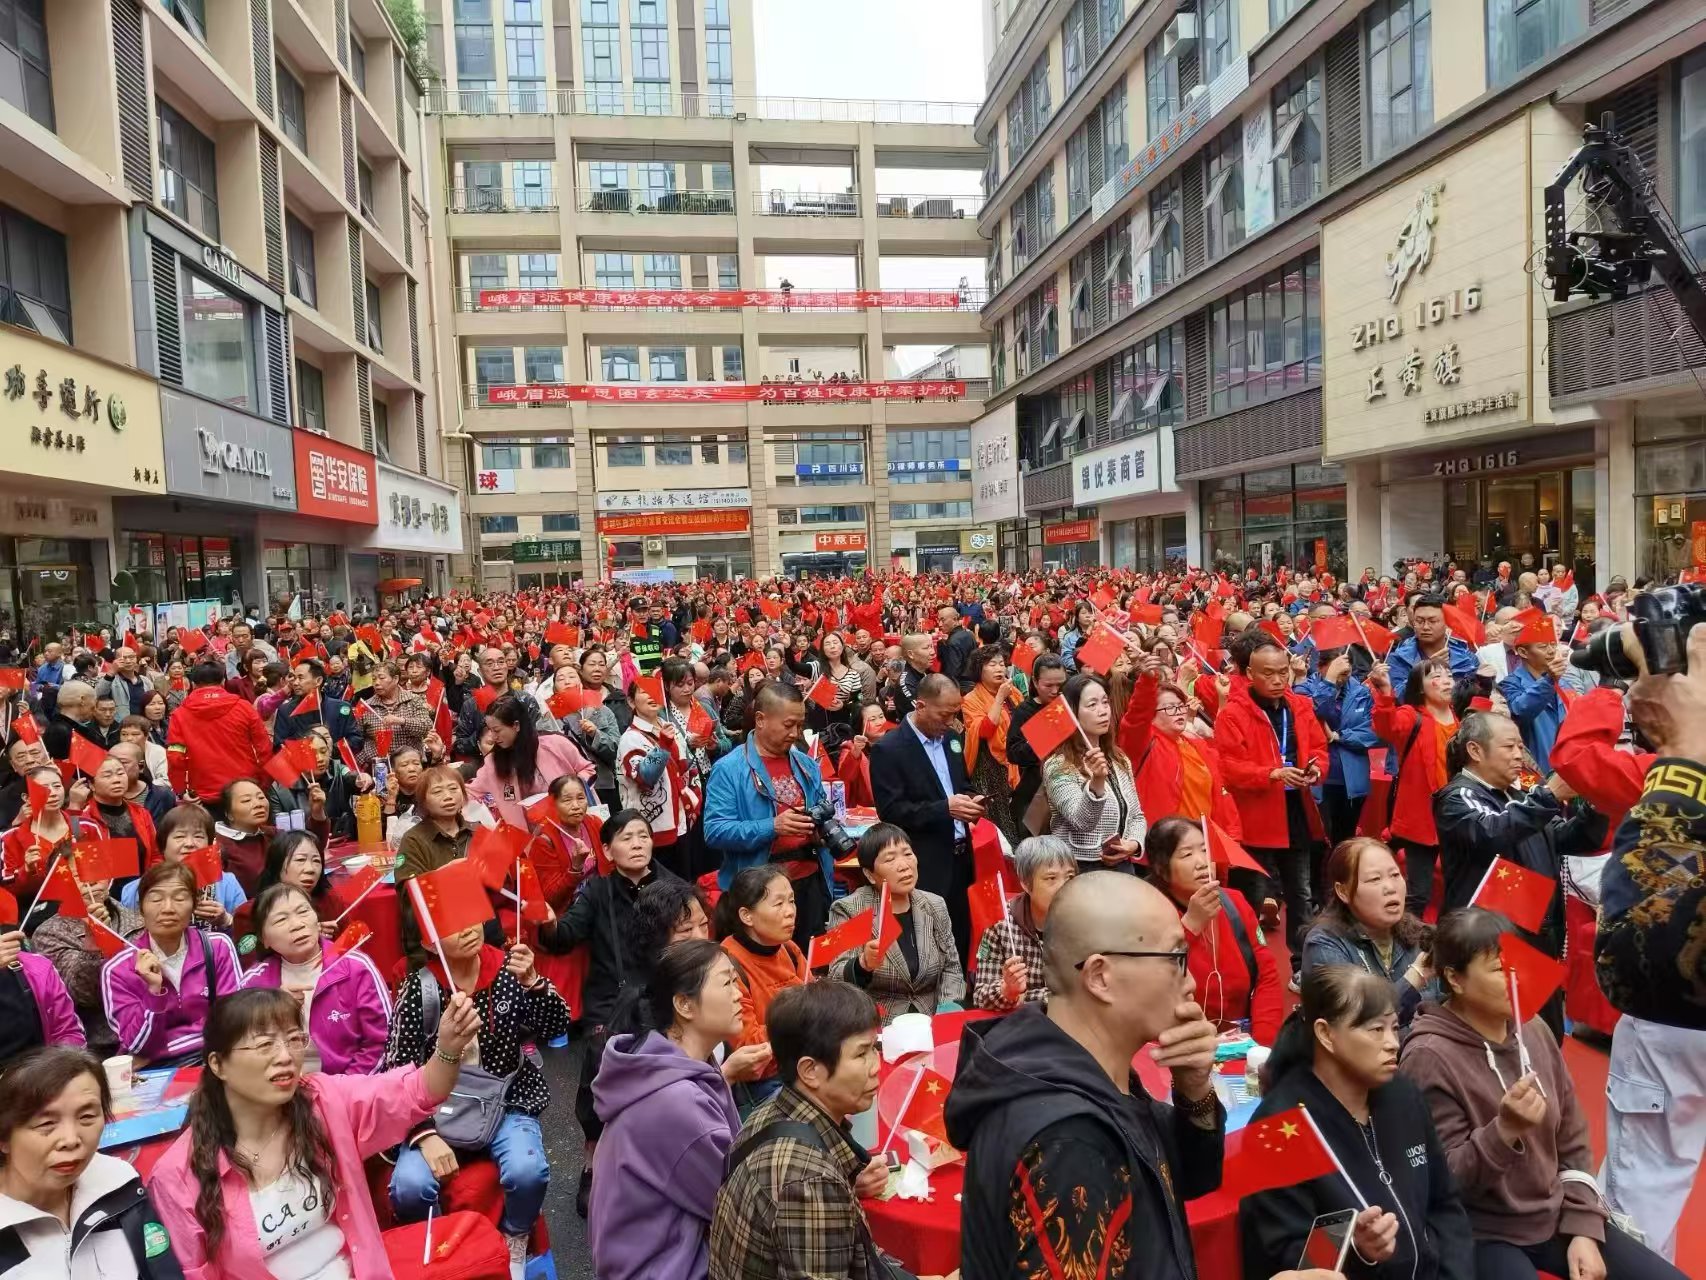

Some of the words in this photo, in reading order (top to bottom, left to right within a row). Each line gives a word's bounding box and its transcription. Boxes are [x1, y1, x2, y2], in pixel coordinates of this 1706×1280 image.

[1351, 313, 1404, 351] ZHQ
[1414, 286, 1482, 329] 1616
[1365, 342, 1462, 402] 正黄旗
[222, 442, 272, 478] CAMEL
[325, 455, 368, 496] 华安保险
[1081, 449, 1145, 490] 锦悦泰商管
[1433, 458, 1469, 475] ZHQ
[1477, 451, 1518, 470] 1616
[479, 472, 499, 490] 球
[818, 534, 867, 546] 中意百
